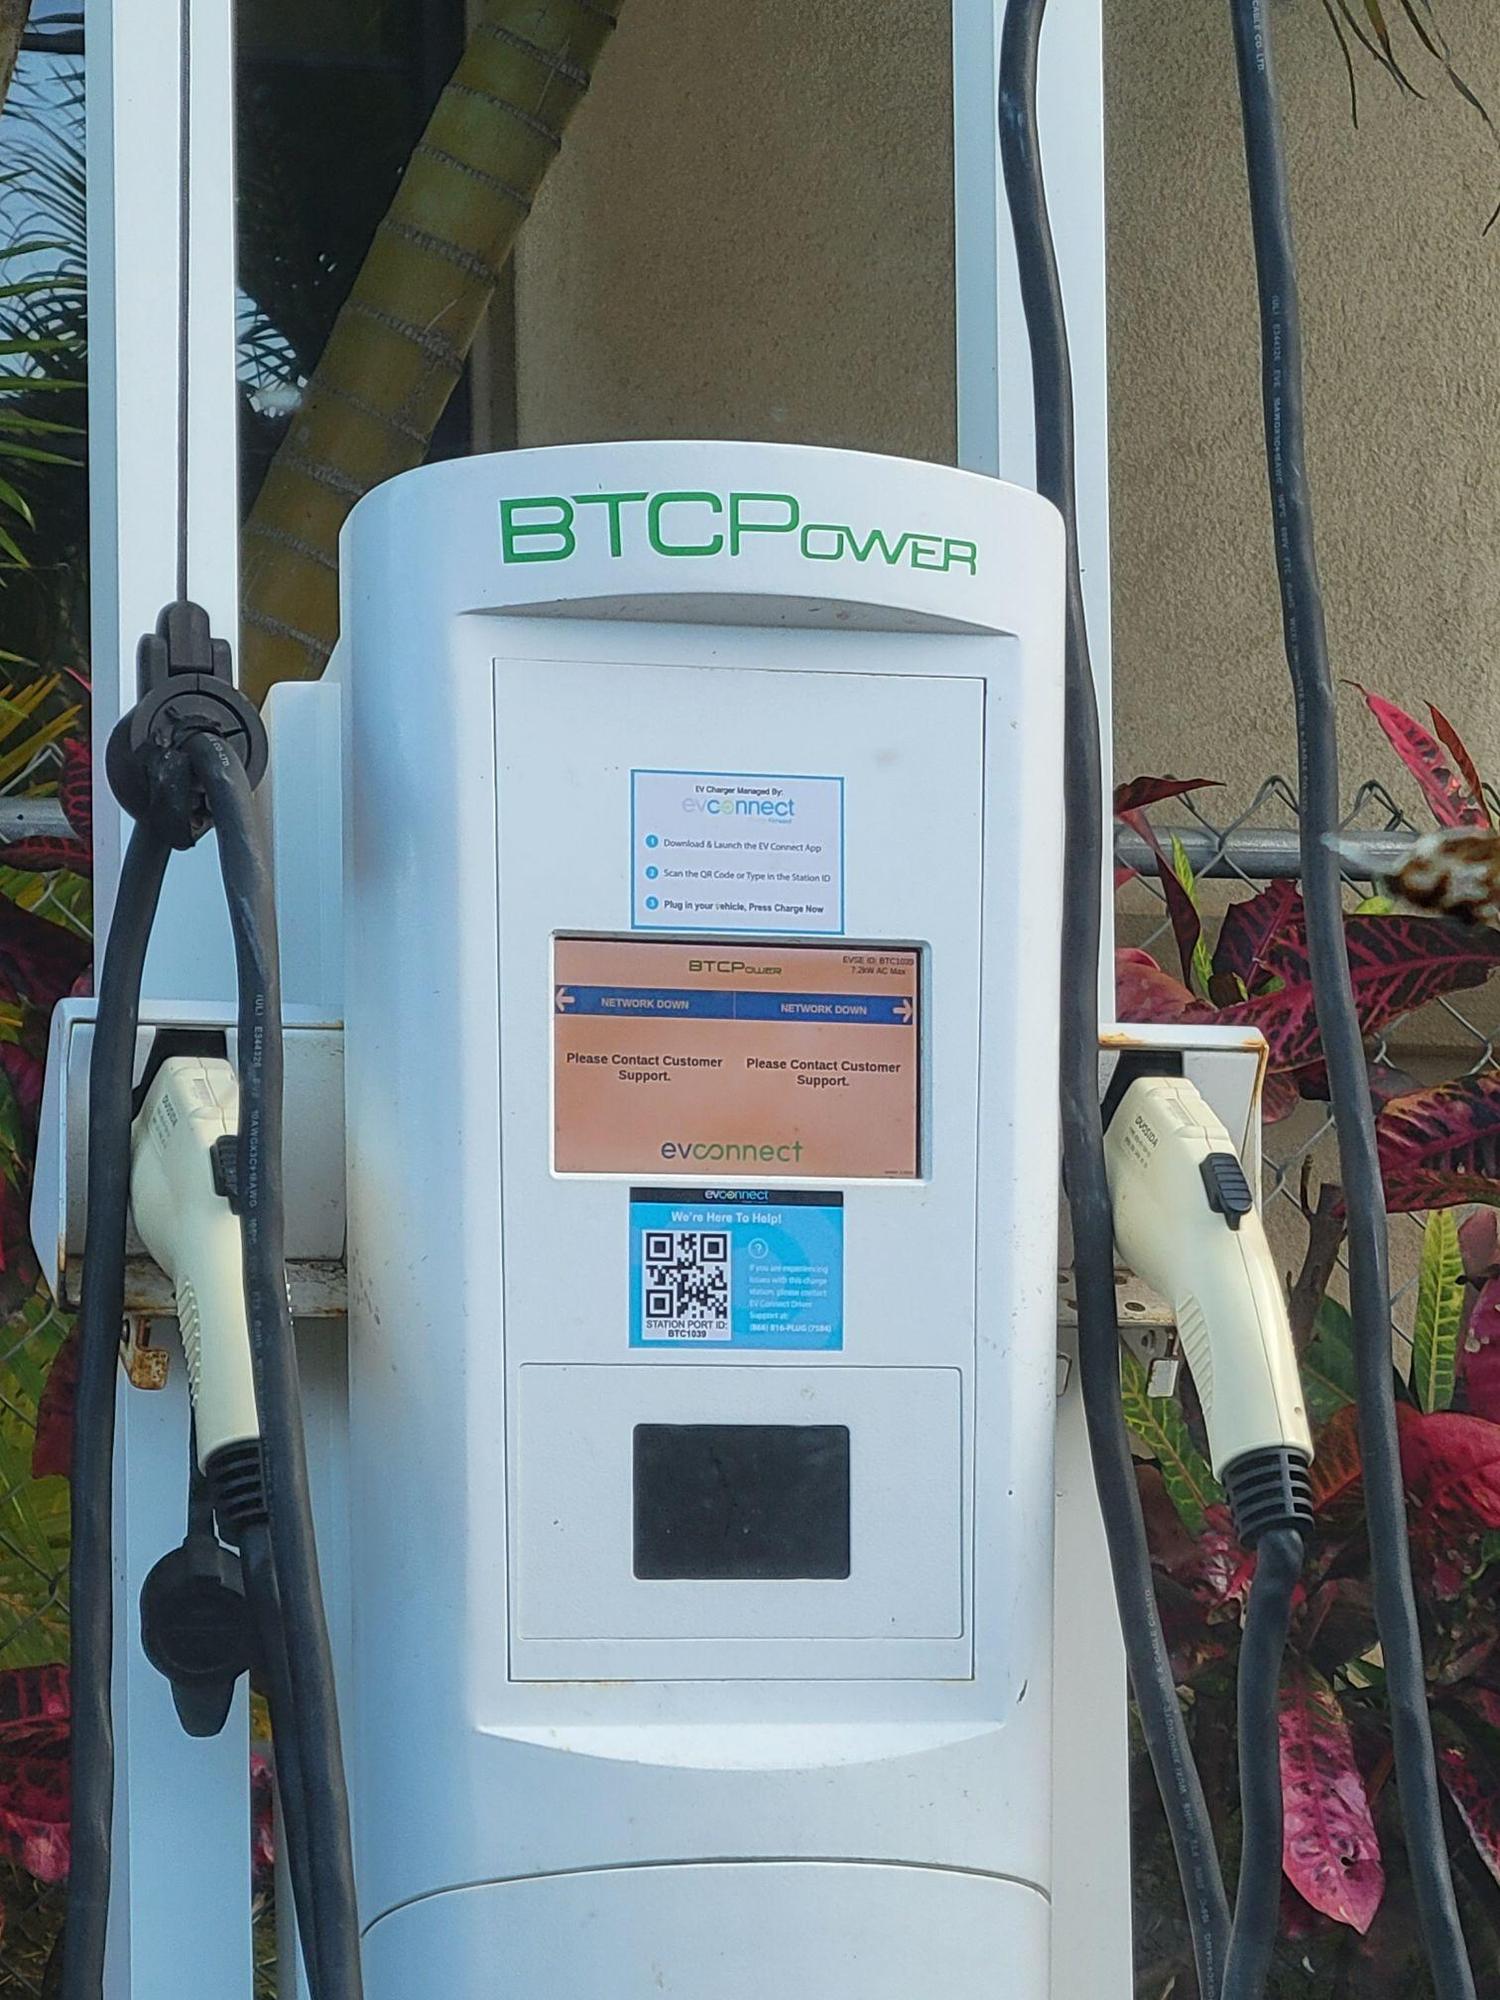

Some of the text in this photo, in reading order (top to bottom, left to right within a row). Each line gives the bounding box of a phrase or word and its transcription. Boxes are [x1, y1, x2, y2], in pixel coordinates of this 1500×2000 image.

[706, 785, 735, 795] Charger
[737, 787, 770, 796] Managed
[664, 838, 705, 848] Download
[706, 840, 712, 849] &
[714, 841, 742, 849] Launch
[744, 842, 757, 850] the
[759, 842, 769, 850] EV
[770, 842, 804, 851] Connect
[805, 844, 822, 853] App
[664, 869, 684, 877] Scan
[685, 869, 699, 878] the
[700, 870, 712, 879] QR
[714, 870, 735, 879] Code
[746, 872, 766, 882] Type
[792, 873, 820, 881] Station
[822, 874, 831, 882] ID
[664, 900, 683, 911] Plug
[685, 901, 693, 909] in
[694, 903, 714, 911] your
[749, 902, 772, 912] Press
[774, 903, 804, 914] Charge
[805, 904, 824, 913] Now
[876, 967, 888, 975] AC
[601, 998, 689, 1010] NETWORK DOWN
[780, 1003, 867, 1015] NETWORK DOWN
[566, 1052, 723, 1068] Please Contact Customer
[746, 1058, 901, 1073] Please Contact Customer
[618, 1069, 671, 1082] Support.
[796, 1074, 850, 1087] Support.
[661, 1141, 803, 1162] evconnect
[705, 1190, 769, 1200] evconnect
[671, 1211, 782, 1226] We're Here To Help!
[646, 1320, 728, 1329] STATION PORT ID:
[668, 1329, 707, 1338] BTC1039
